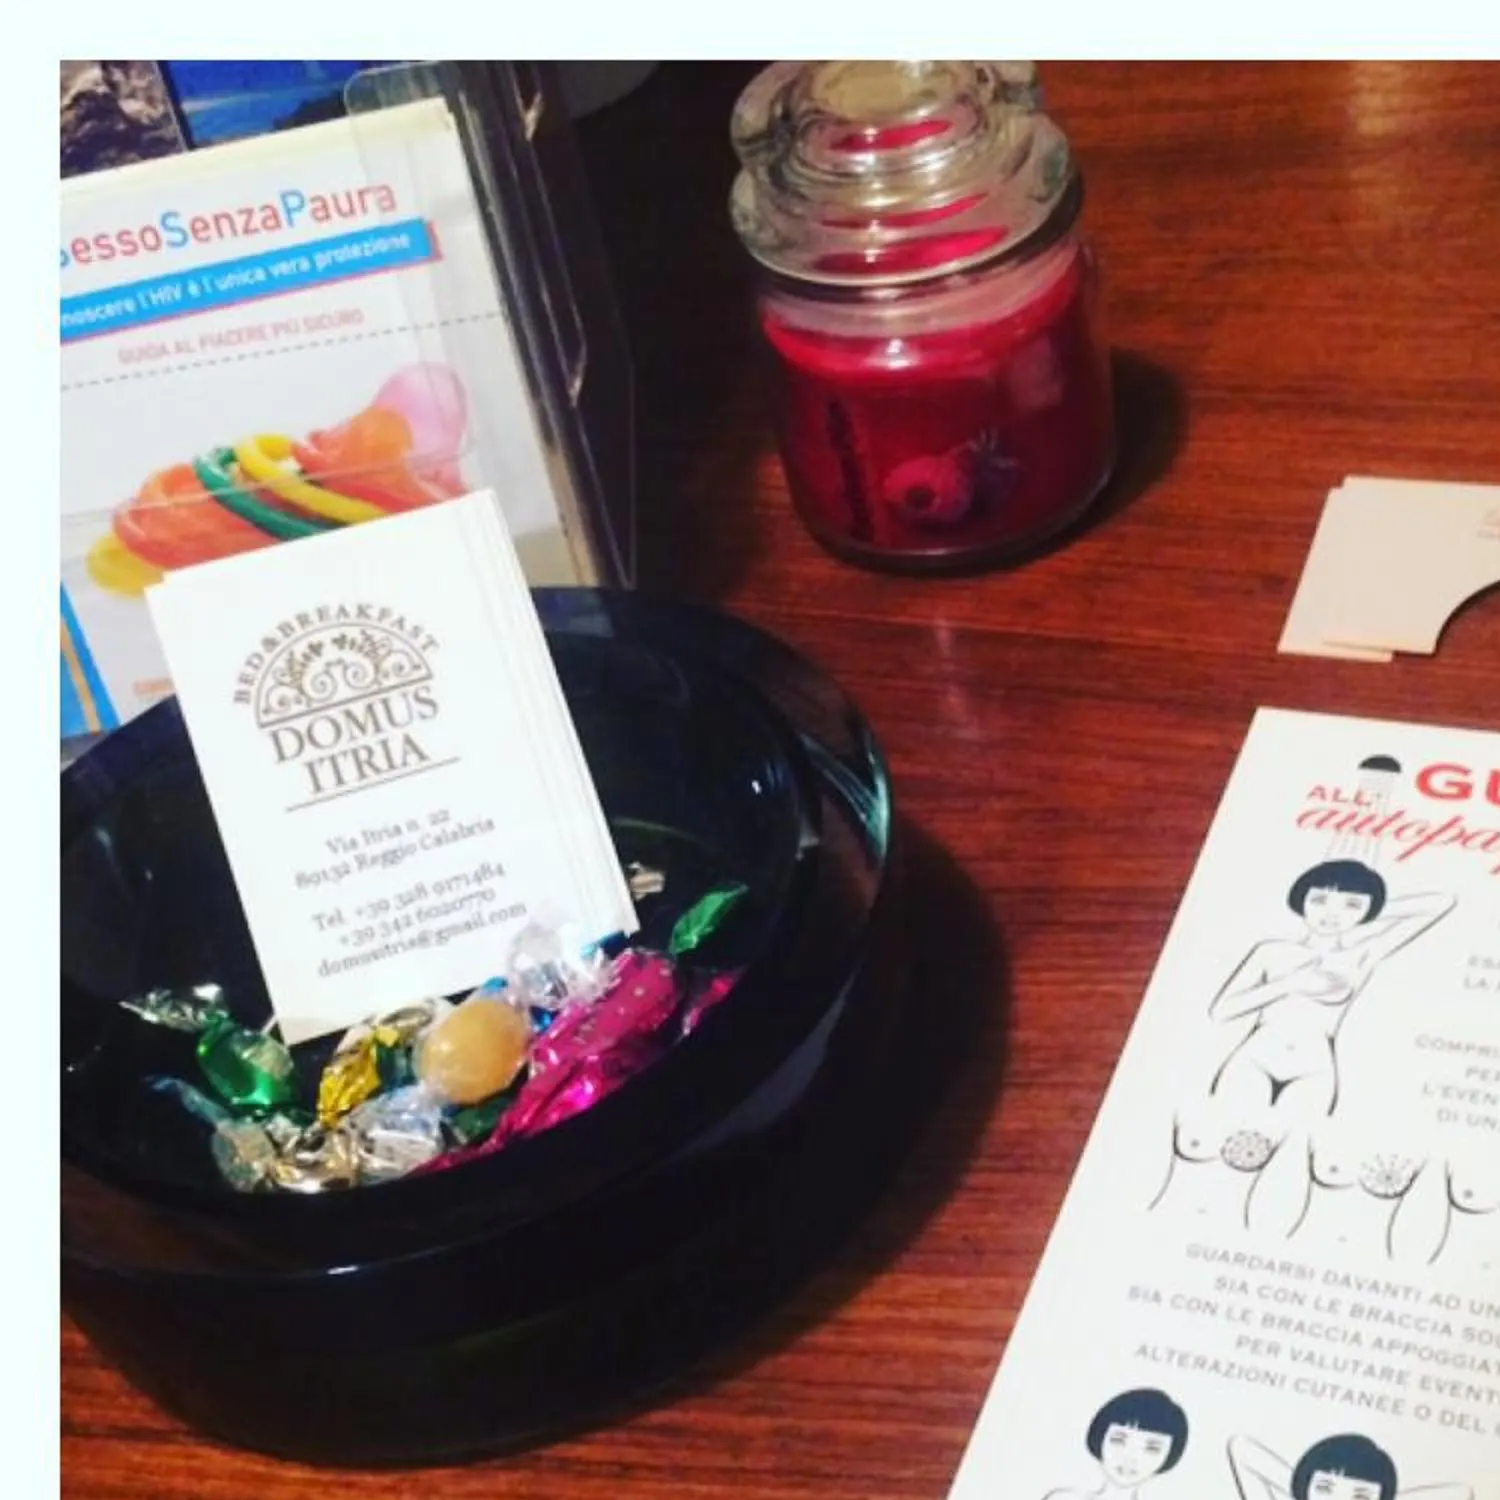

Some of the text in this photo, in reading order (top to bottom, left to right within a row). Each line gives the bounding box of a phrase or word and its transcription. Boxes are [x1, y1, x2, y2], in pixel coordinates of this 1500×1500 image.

[270, 260, 312, 282] vera
[315, 233, 410, 271] protezione
[119, 341, 171, 364] GUIDA
[173, 338, 197, 355] AL
[199, 324, 270, 351] PIACERE
[303, 309, 365, 334] SICURO
[270, 685, 439, 764] DOMUS
[304, 732, 430, 793] ITRIA
[325, 836, 358, 855] Via
[361, 824, 403, 846] Itria
[353, 842, 417, 872] Reggio
[419, 818, 496, 851] Calabria
[355, 898, 391, 918] +39
[394, 881, 428, 910] 328
[339, 926, 376, 947] +39
[378, 915, 413, 938] 342
[1463, 976, 1490, 991] LA
[1436, 1106, 1459, 1125] DI
[1186, 1242, 1316, 1280] GUARDARSI
[1322, 1268, 1423, 1303] DAVANTI
[1429, 1292, 1462, 1311] AD
[1128, 1285, 1163, 1305] SIA
[1170, 1293, 1219, 1317] CON
[1226, 1306, 1253, 1324] LE
[1260, 1312, 1364, 1348] BRACCIA
[1215, 1276, 1249, 1295] SIA
[1256, 1284, 1306, 1306] CON
[1313, 1296, 1342, 1314] LE
[1349, 1301, 1453, 1337] BRACCIA
[1235, 1335, 1282, 1358] PER
[1290, 1347, 1411, 1386] VALUTARE
[1134, 1344, 1288, 1389] ALTERAZIONI
[1293, 1377, 1408, 1416] CUTANEE
[1414, 1404, 1431, 1421] O
[1439, 1409, 1487, 1435] DEL
